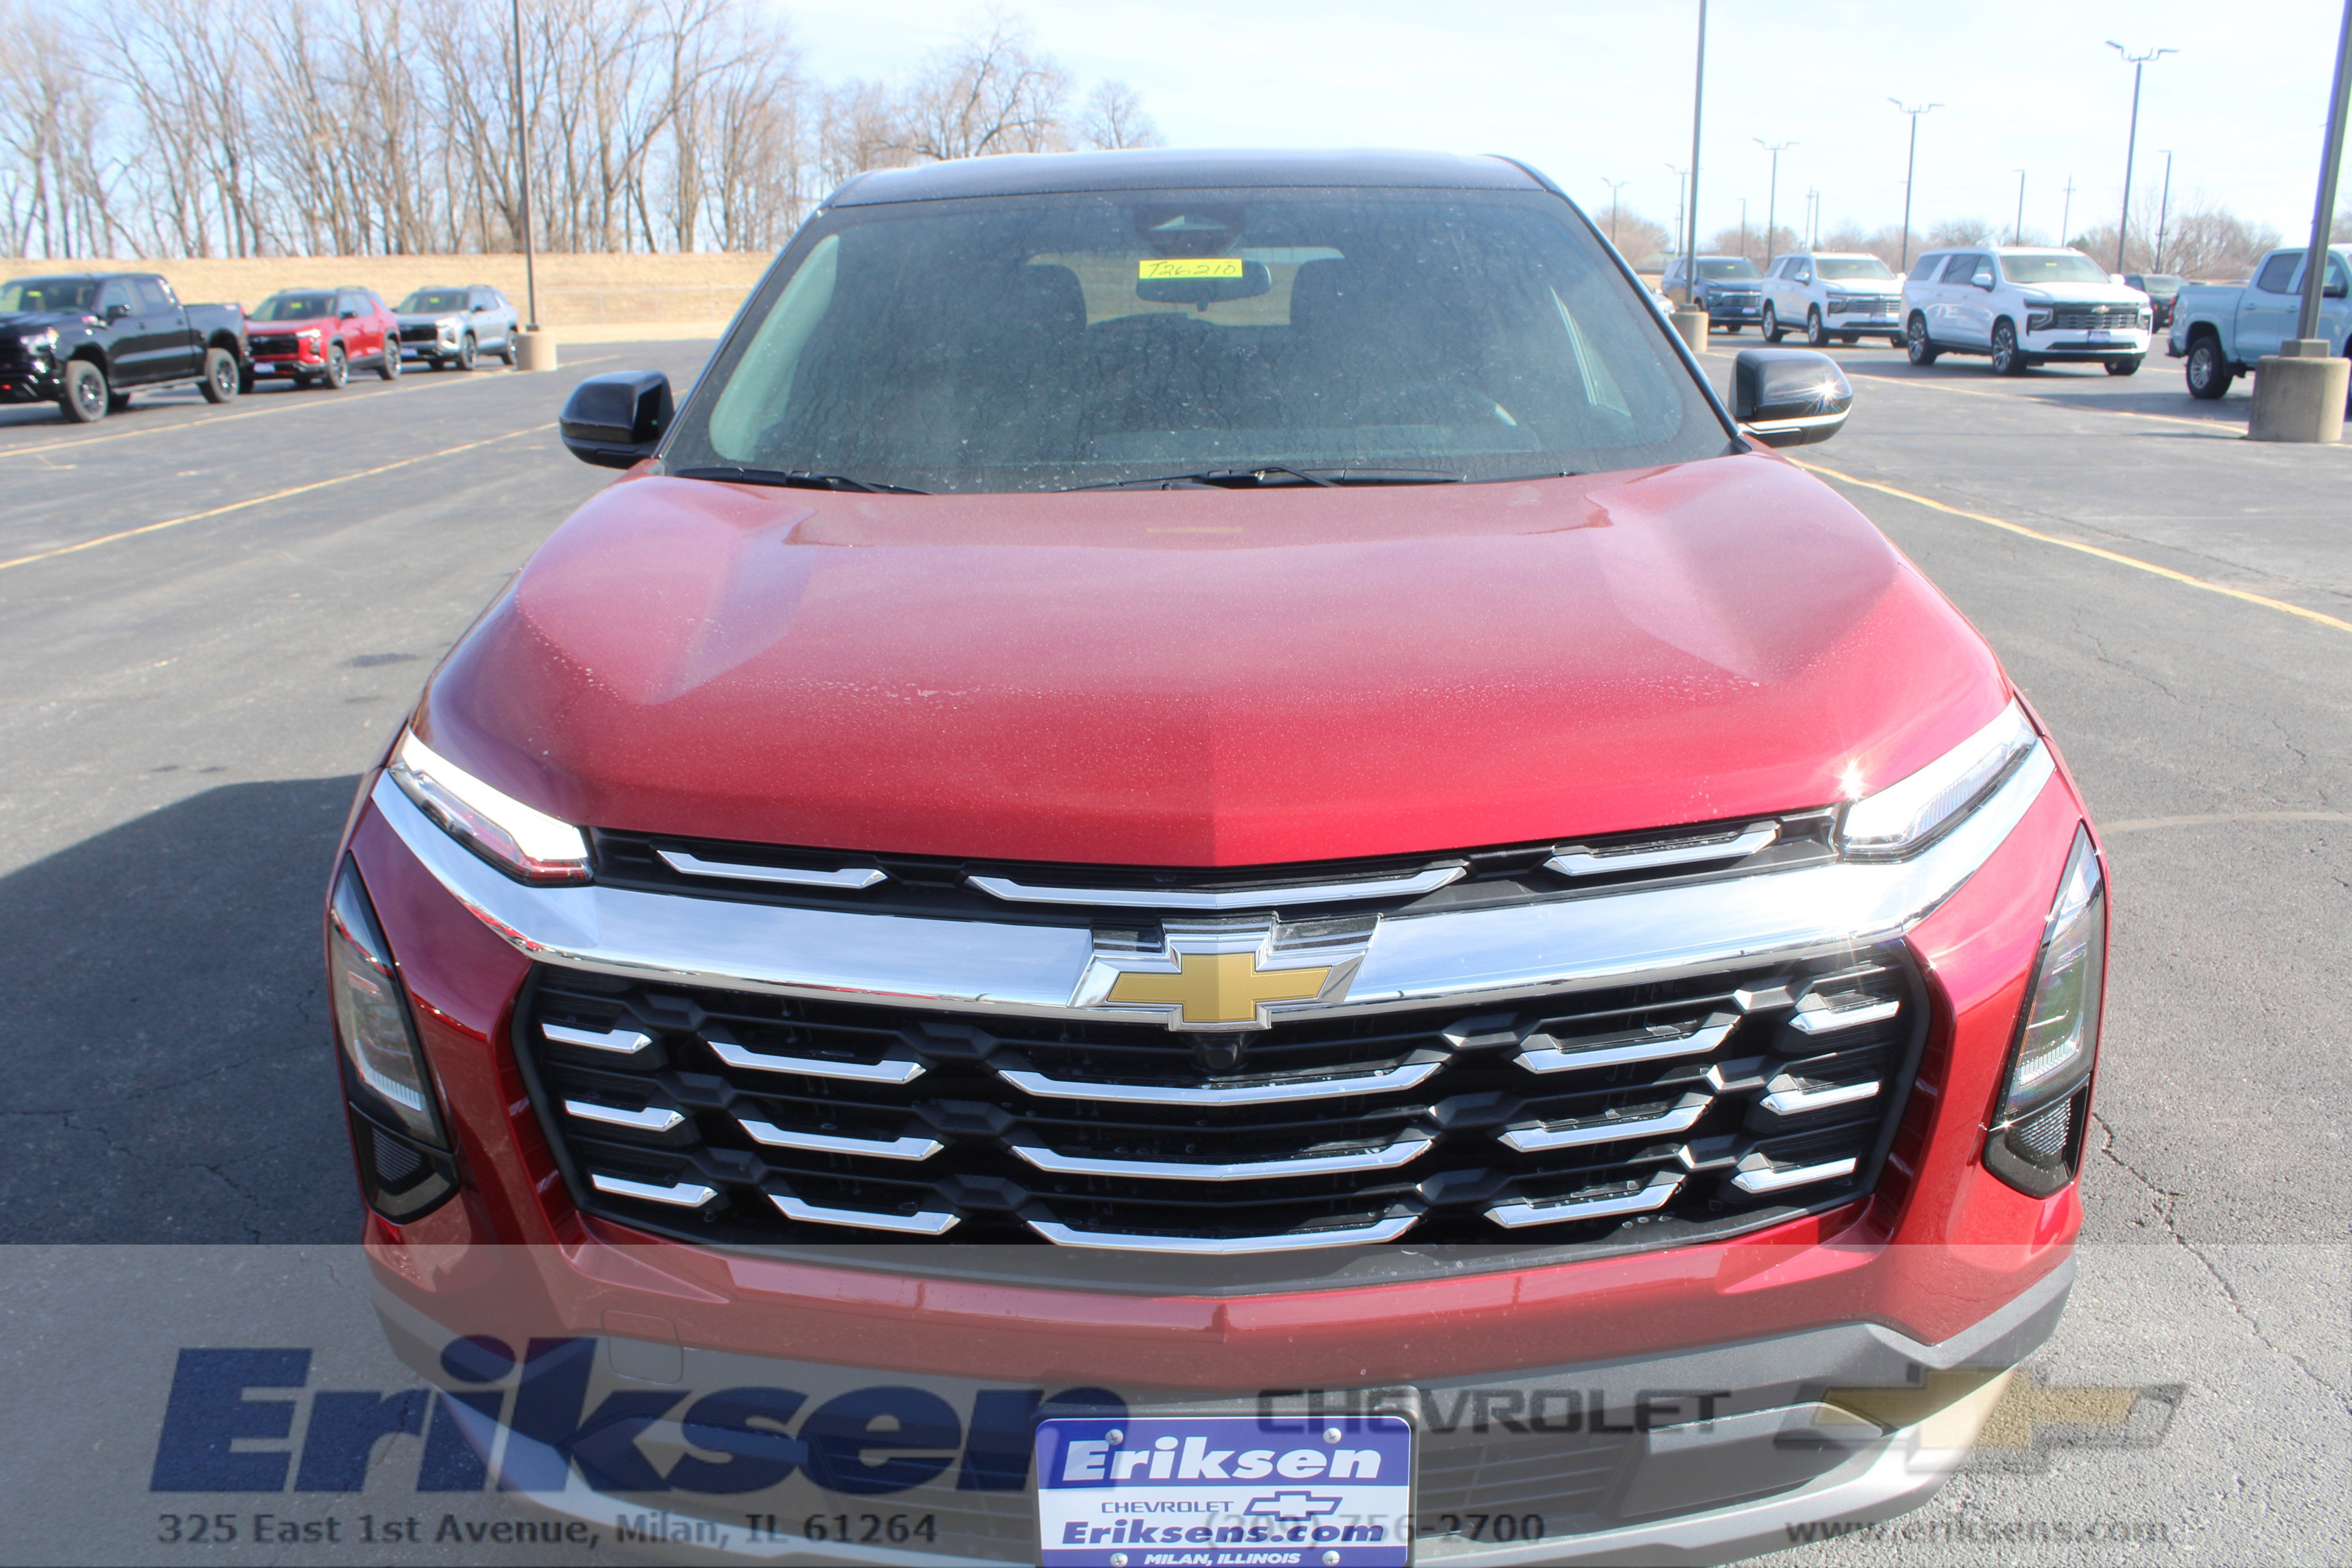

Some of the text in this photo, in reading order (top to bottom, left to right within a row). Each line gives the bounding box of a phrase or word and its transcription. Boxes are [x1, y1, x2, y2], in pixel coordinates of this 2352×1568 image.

[1062, 1436, 1382, 1481] Eriksen
[1101, 1501, 1234, 1513] CHEVROLET
[1062, 1519, 1383, 1544] Eriksens.com
[1144, 1552, 1301, 1567] MILAN, ILLINOIS
